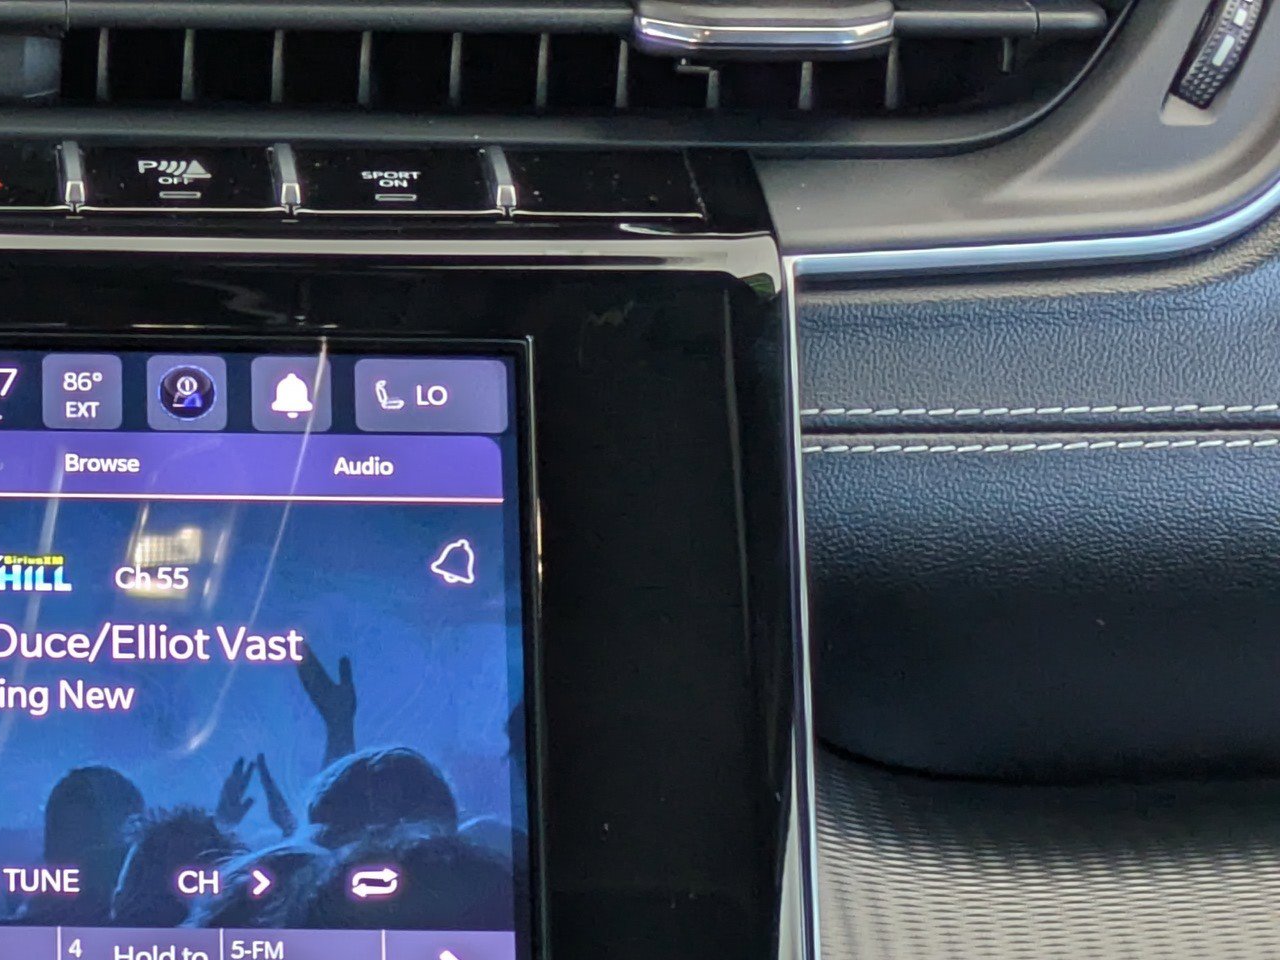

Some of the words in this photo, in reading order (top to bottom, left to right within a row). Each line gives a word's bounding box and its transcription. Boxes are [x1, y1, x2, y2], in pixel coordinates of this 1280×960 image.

[158, 176, 194, 185] OFF
[361, 170, 421, 179] SPORT
[378, 179, 408, 188] ON
[62, 371, 103, 392] 86°
[416, 385, 448, 406] LO
[65, 401, 99, 419] EXT
[64, 454, 141, 473] Browse
[333, 456, 394, 476] Audio
[115, 566, 152, 590] Ch
[157, 567, 189, 590] 55
[216, 625, 304, 662] Vast
[59, 680, 135, 710] New
[3, 868, 80, 893] TUNE
[177, 870, 219, 895] CH
[68, 939, 83, 958] 4
[231, 941, 285, 960] 5-FM
